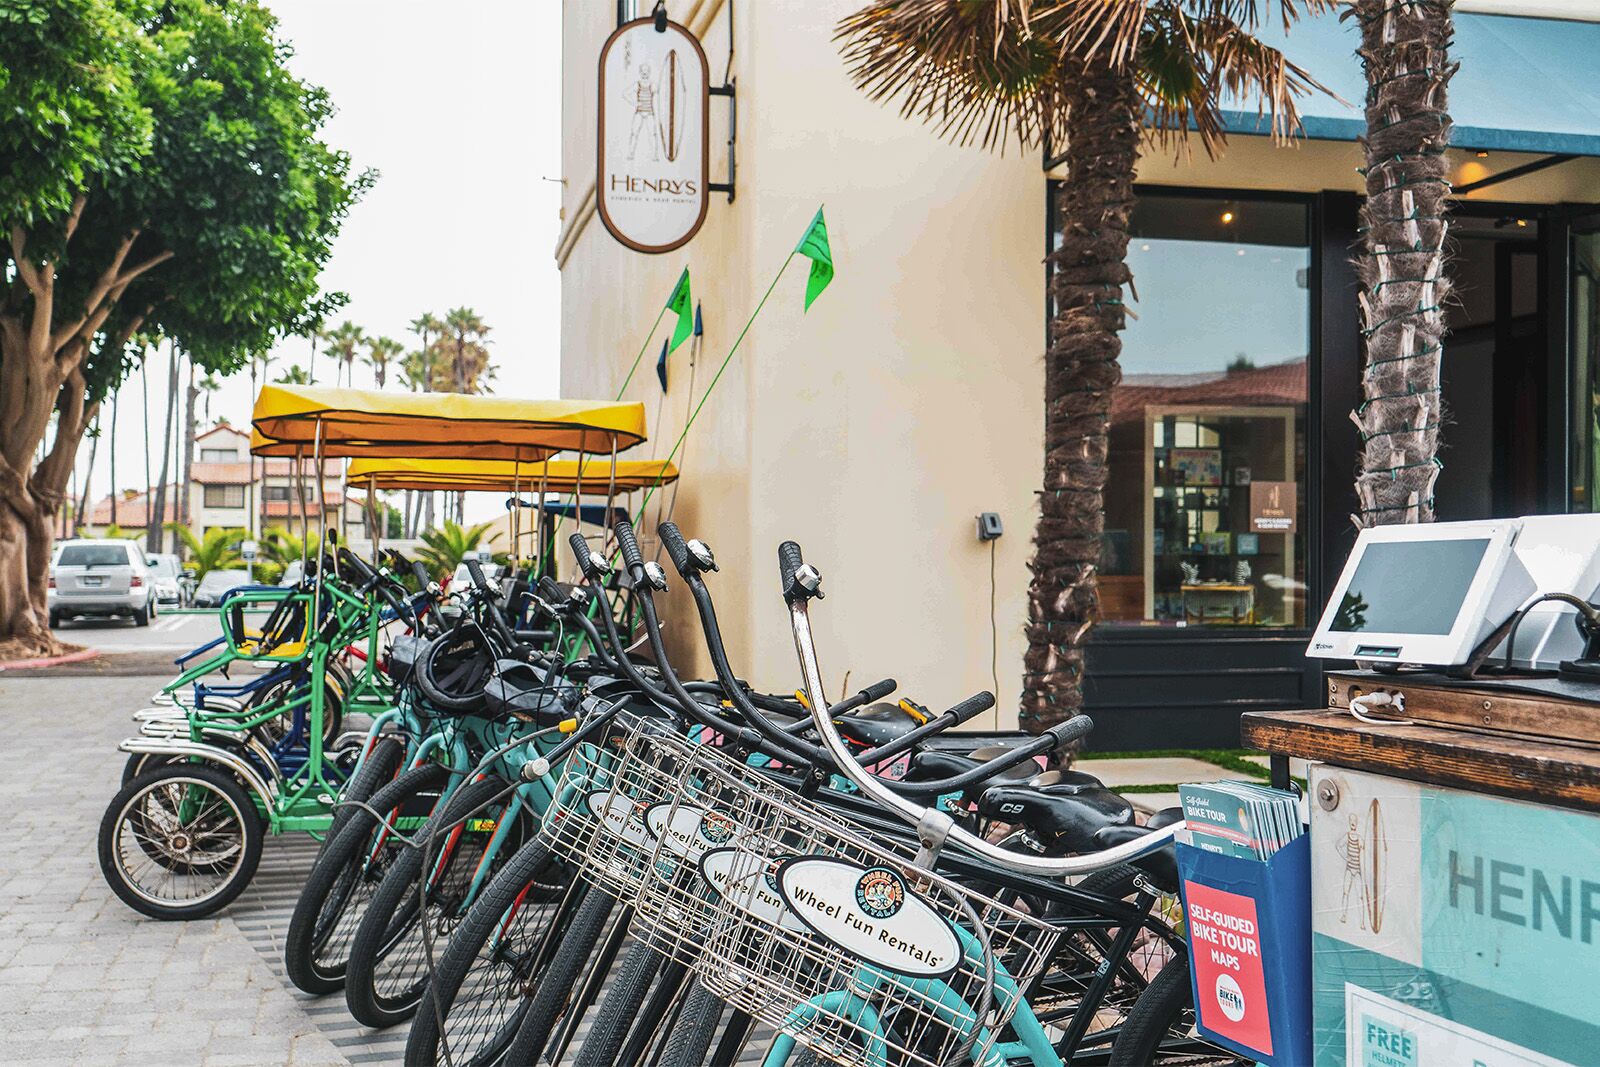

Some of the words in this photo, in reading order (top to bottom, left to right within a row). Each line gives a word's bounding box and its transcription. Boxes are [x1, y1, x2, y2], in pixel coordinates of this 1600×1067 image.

[611, 174, 697, 195] HENRYS
[1000, 803, 1025, 814] C9
[1187, 806, 1206, 819] BIKE
[1205, 809, 1227, 823] TOUR
[626, 821, 642, 834] Fun
[861, 871, 892, 884] WHEEL
[757, 890, 781, 908] Fun
[857, 889, 896, 917] RENTALS
[794, 886, 841, 919] Wheel
[844, 912, 873, 936] Fun
[1190, 904, 1255, 935] SELF-GUIDED
[1192, 920, 1219, 945] BIKE
[1218, 929, 1258, 957] TOUR
[1211, 949, 1240, 971] MAPS
[1219, 989, 1233, 1002] BIKE
[1367, 1023, 1411, 1060] FREE
